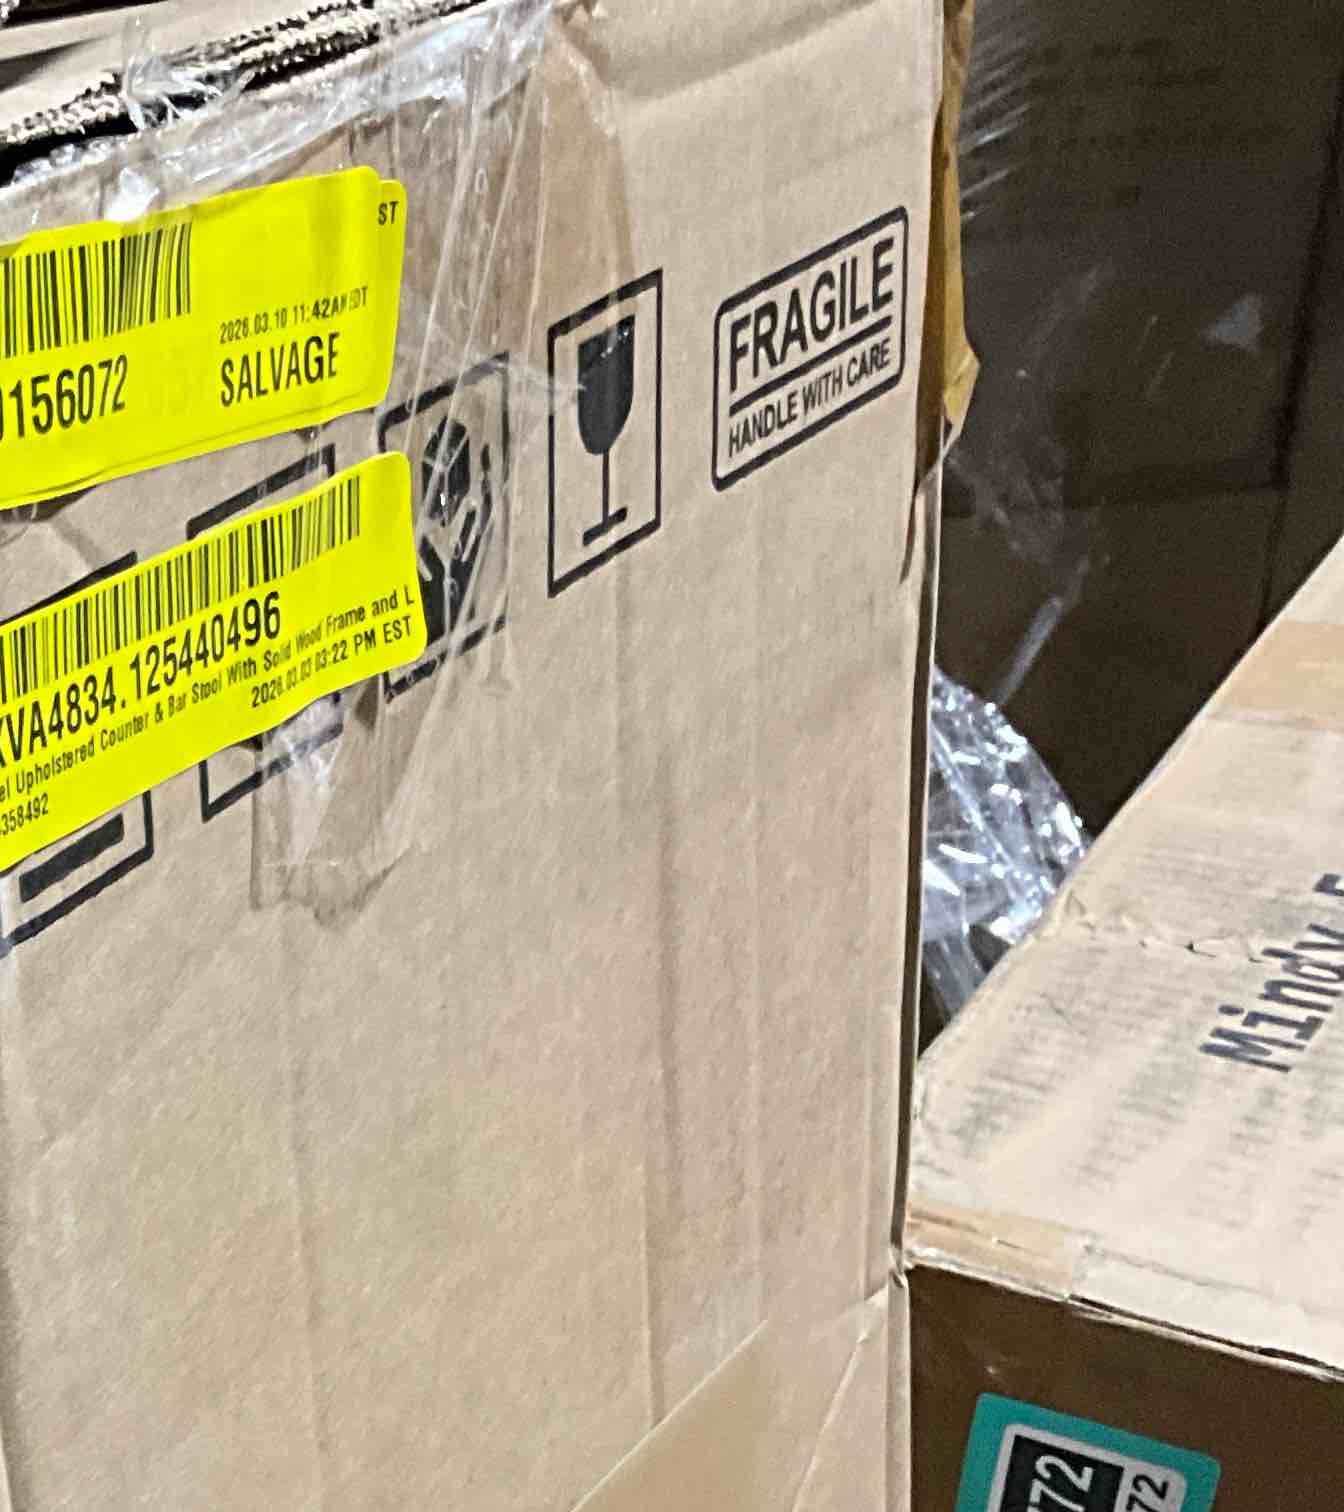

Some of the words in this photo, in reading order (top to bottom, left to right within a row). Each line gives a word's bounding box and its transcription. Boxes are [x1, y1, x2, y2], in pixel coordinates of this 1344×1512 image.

[378, 201, 399, 225] ST
[729, 236, 894, 393] FRAGILE
[221, 332, 340, 407] SALVAGE
[728, 391, 798, 458] HANDLE
[802, 363, 844, 417] WITH
[847, 337, 891, 388] CARE
[353, 628, 376, 655] PM
[384, 615, 413, 644] EST
[15, 736, 96, 794] Upholstered
[100, 710, 149, 750] Counter
[154, 701, 164, 723] &
[168, 690, 187, 713] Bar
[191, 673, 222, 704] Stool
[226, 655, 257, 686] With
[326, 606, 366, 631] Frame
[371, 589, 399, 615] and
[404, 586, 415, 606] L
